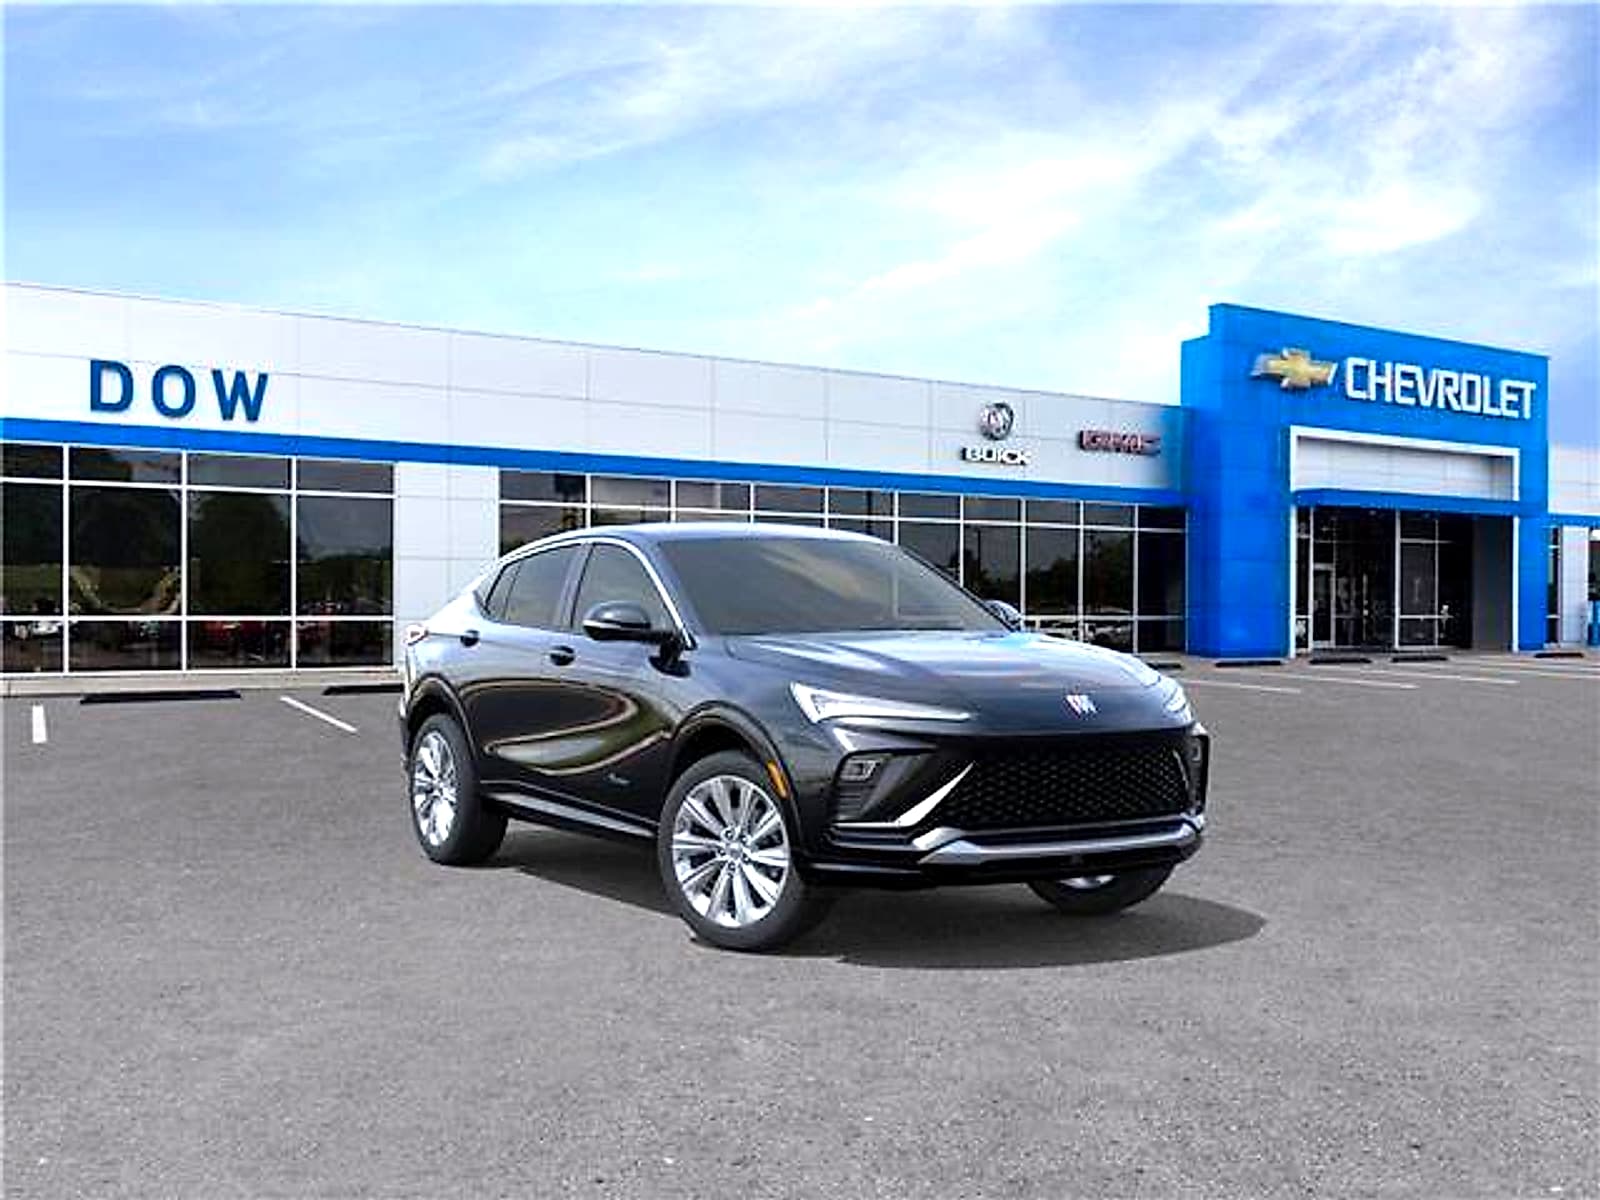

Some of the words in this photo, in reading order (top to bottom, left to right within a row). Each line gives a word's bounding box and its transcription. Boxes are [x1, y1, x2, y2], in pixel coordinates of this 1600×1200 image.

[90, 359, 269, 421] DOW
[1346, 357, 1537, 419] CHEVROLET
[963, 446, 1032, 465] BUICK
